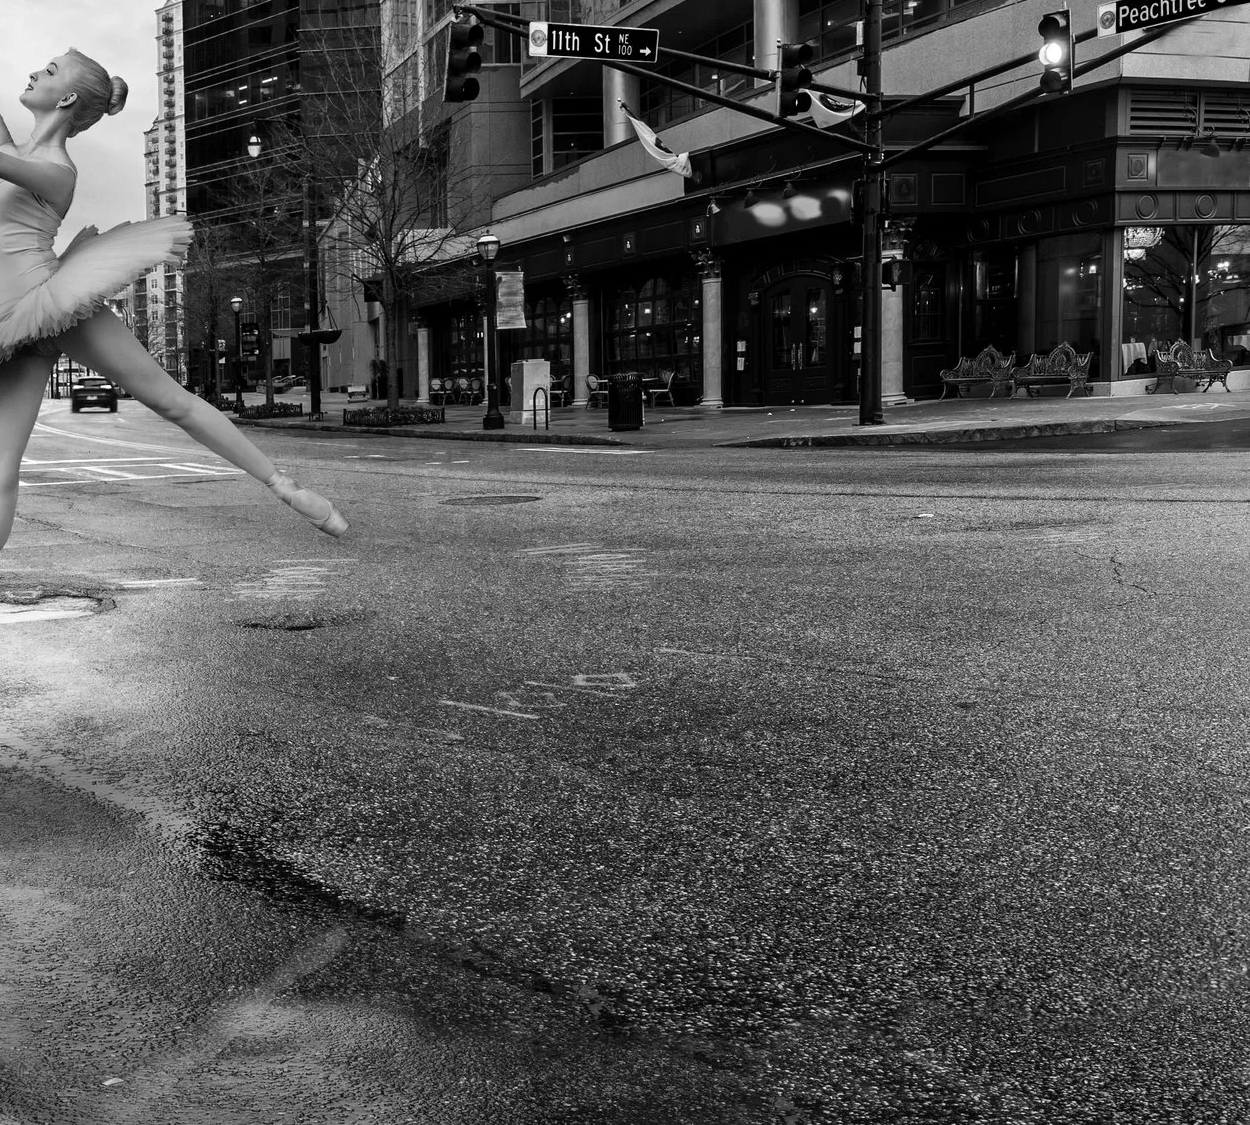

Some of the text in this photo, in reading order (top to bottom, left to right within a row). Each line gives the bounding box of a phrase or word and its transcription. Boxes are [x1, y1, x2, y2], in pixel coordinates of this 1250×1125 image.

[552, 30, 630, 53] 11th St NE
[618, 44, 633, 55] 100
